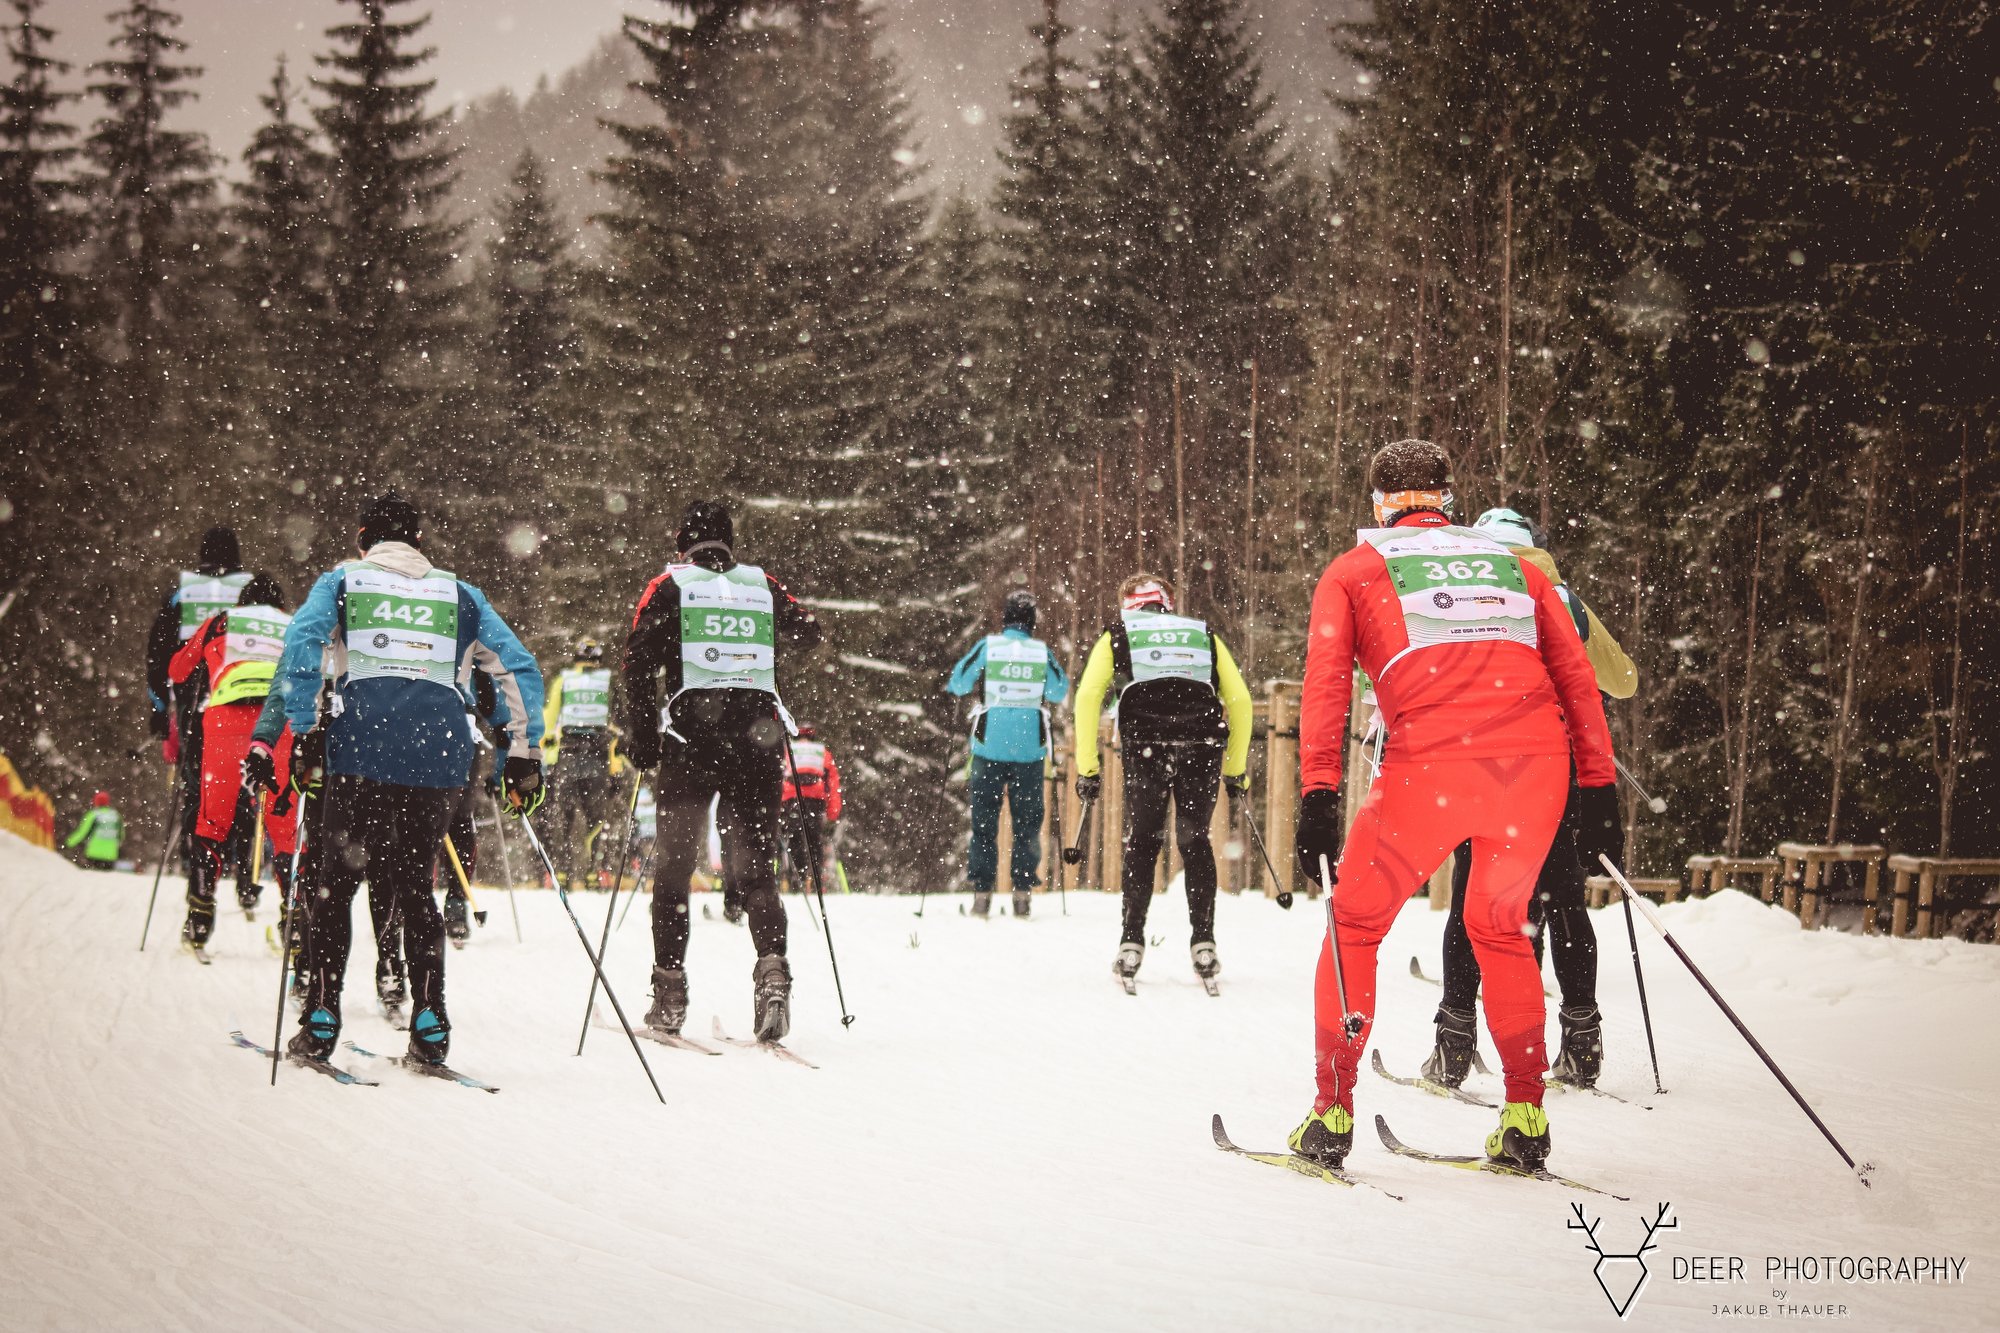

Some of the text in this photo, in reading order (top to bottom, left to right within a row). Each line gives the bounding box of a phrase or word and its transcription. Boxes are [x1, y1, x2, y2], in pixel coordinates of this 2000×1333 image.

[1422, 560, 1498, 580] 362
[373, 600, 434, 626] 442
[246, 620, 287, 637] 437
[704, 614, 756, 637] 529
[1148, 632, 1191, 644] 497
[1000, 665, 1033, 679] 498
